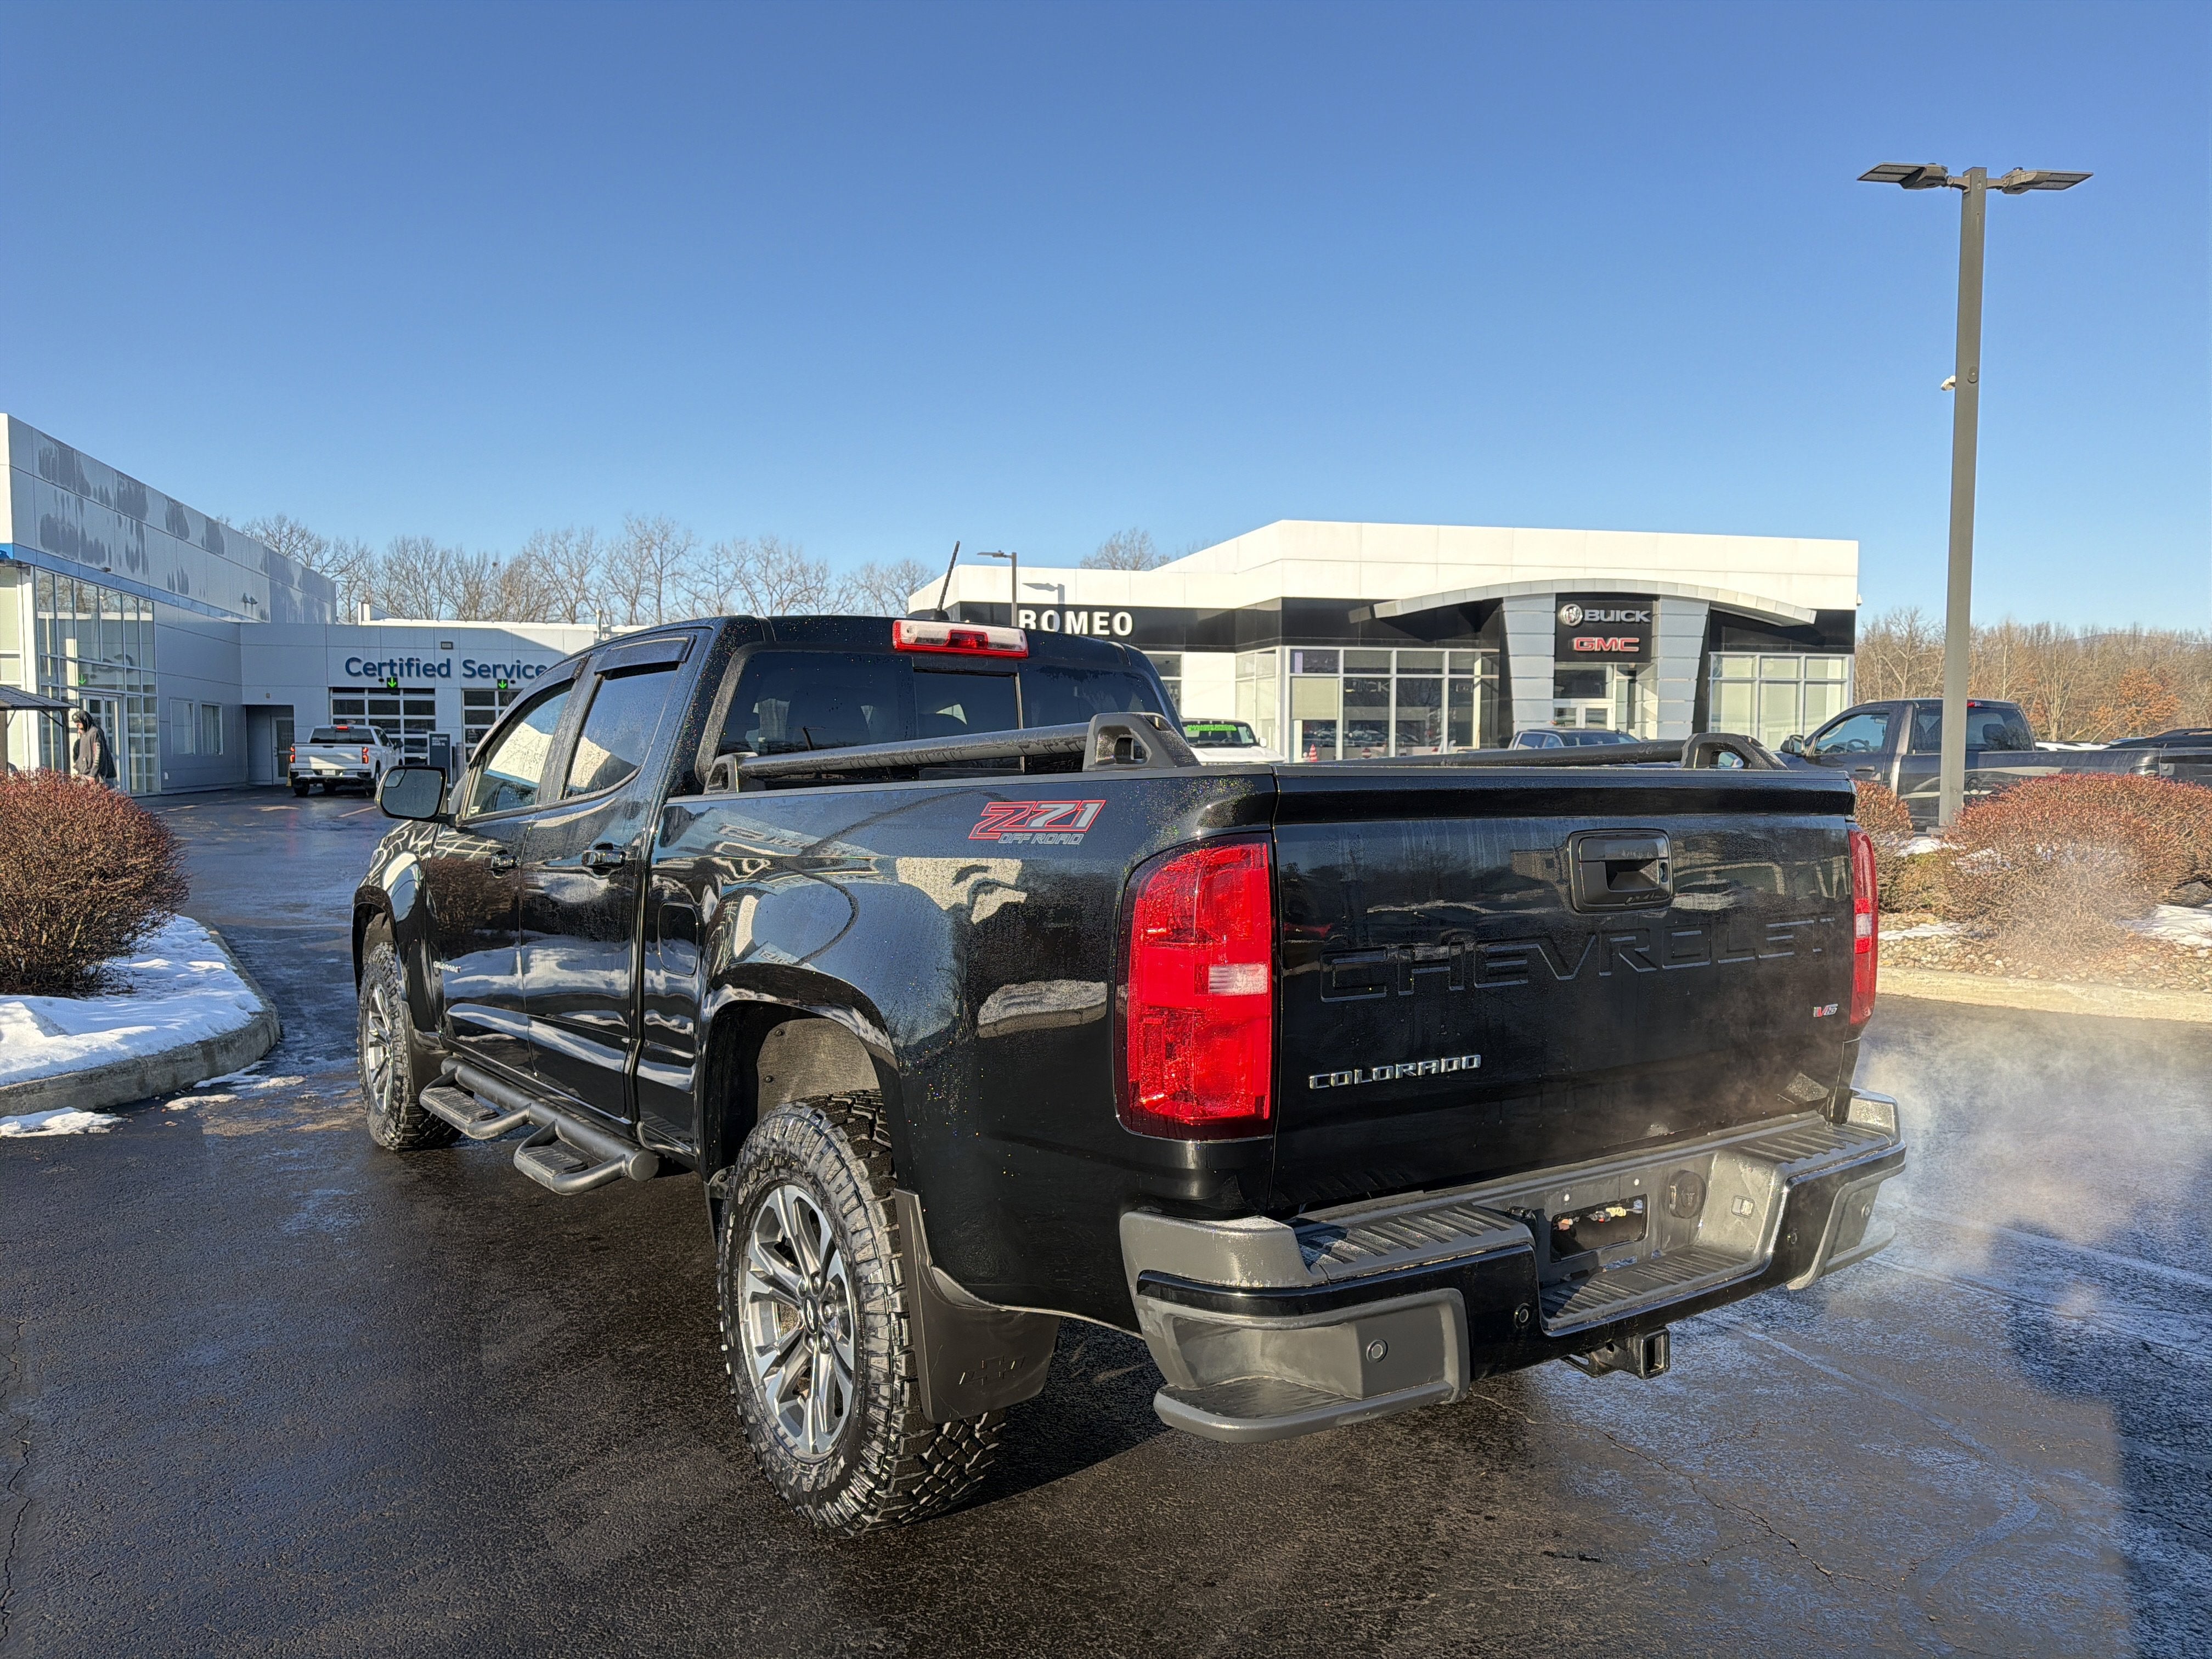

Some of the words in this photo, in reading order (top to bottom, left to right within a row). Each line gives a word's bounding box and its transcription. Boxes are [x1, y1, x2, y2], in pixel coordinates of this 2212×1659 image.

[1019, 610, 1133, 636] ROMEO
[1584, 609, 1651, 622] BUICK
[1573, 637, 1639, 652] GMC
[345, 657, 450, 678] Certified
[462, 659, 548, 679] Service
[968, 800, 1106, 839] Z71
[998, 833, 1032, 844] OFF
[1031, 833, 1084, 845] ROAD
[1321, 917, 1836, 1002] CHEVROLET
[1813, 1003, 1838, 1018] V6
[1309, 1054, 1481, 1089] COLORADO
